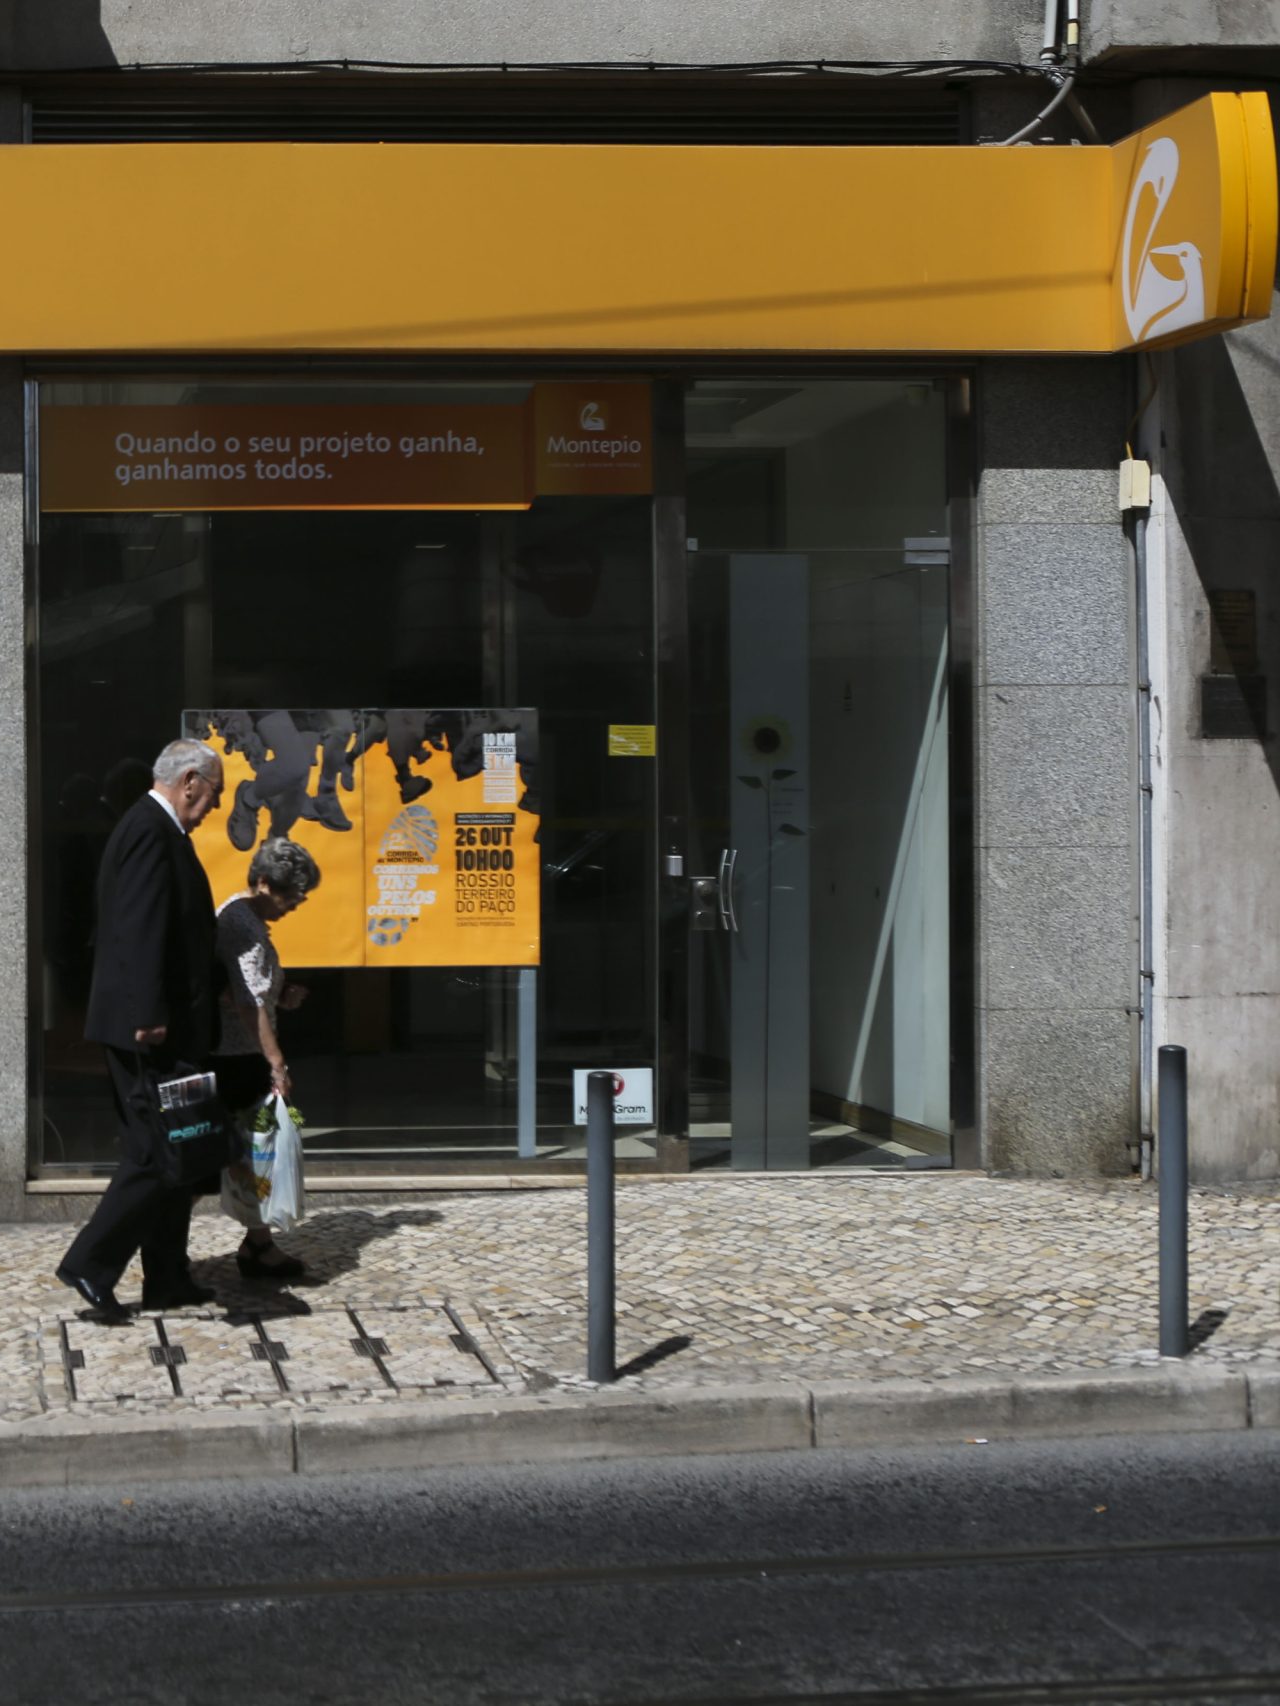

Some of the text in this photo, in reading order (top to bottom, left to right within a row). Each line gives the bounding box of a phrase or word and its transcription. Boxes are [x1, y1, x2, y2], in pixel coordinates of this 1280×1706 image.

[115, 430, 484, 458] Quando o seu projeto ganha,
[547, 435, 642, 458] Montepio
[115, 457, 333, 486] ganhamos todos.
[483, 733, 516, 746] 10 KM
[456, 827, 514, 846] 26 OUT
[456, 849, 514, 871] 10H00
[456, 874, 515, 887] ROSSIO
[378, 890, 437, 904] PELOS
[456, 889, 515, 900] TERREIRO
[457, 901, 515, 916] DO PAÇO
[579, 1104, 646, 1115] MGram
